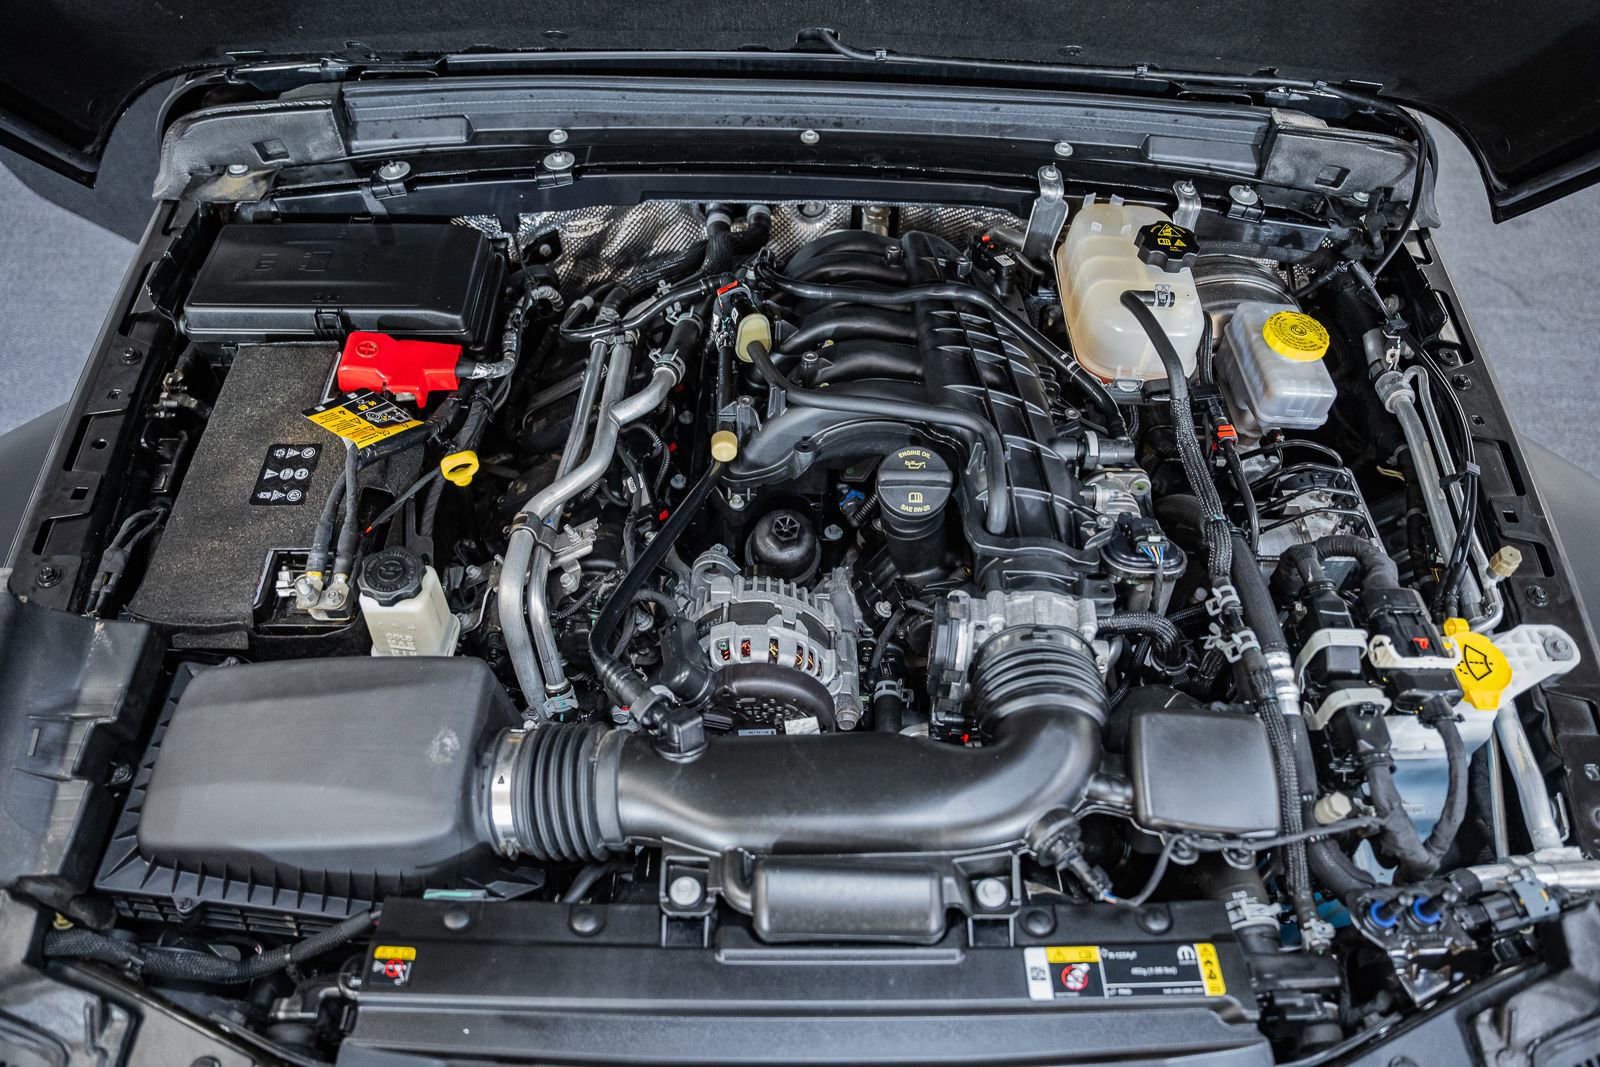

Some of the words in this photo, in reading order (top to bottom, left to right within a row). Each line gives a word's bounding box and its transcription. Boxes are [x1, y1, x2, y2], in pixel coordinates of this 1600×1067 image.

[898, 449, 921, 459] ENGINE
[921, 451, 931, 460] OIL
[900, 503, 913, 513] SAE
[385, 632, 413, 641] COLD
[387, 639, 416, 647] MAX
